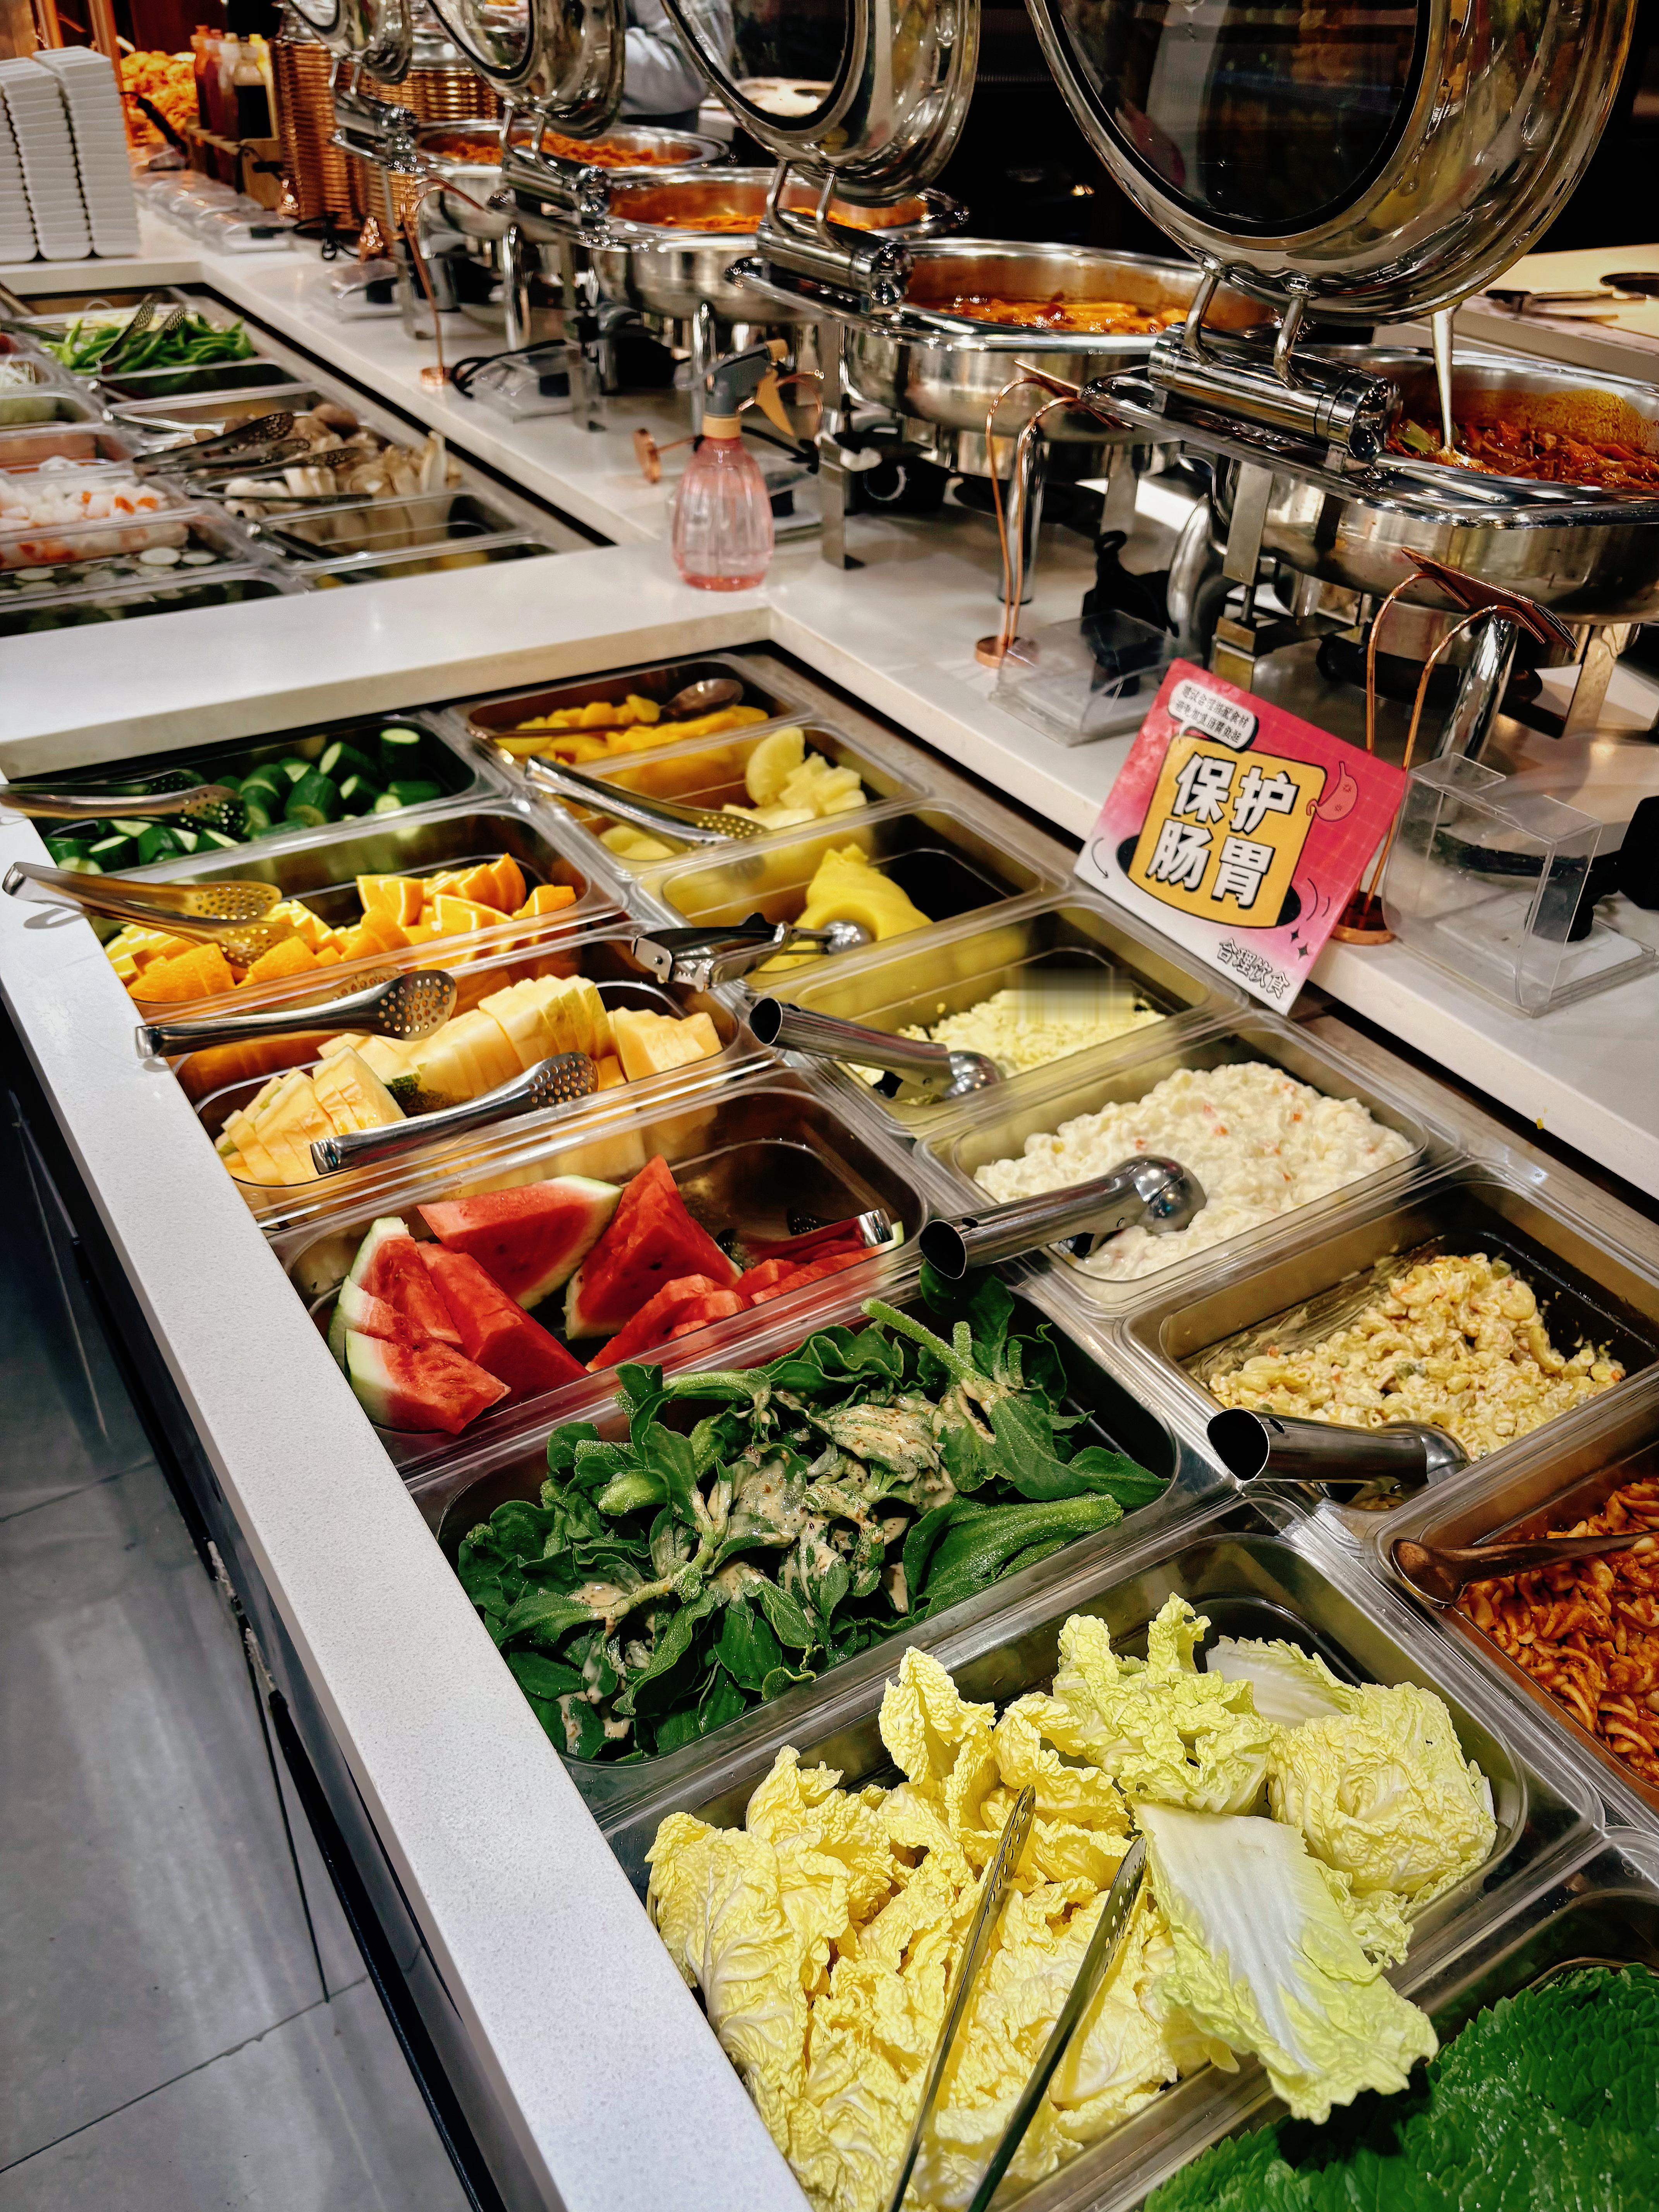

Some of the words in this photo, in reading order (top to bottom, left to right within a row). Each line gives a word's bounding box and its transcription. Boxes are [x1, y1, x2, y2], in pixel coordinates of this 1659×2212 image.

[1172, 753, 1300, 834] 保护
[1145, 819, 1275, 910] 肠胃
[1217, 937, 1290, 998] 合理饮食
